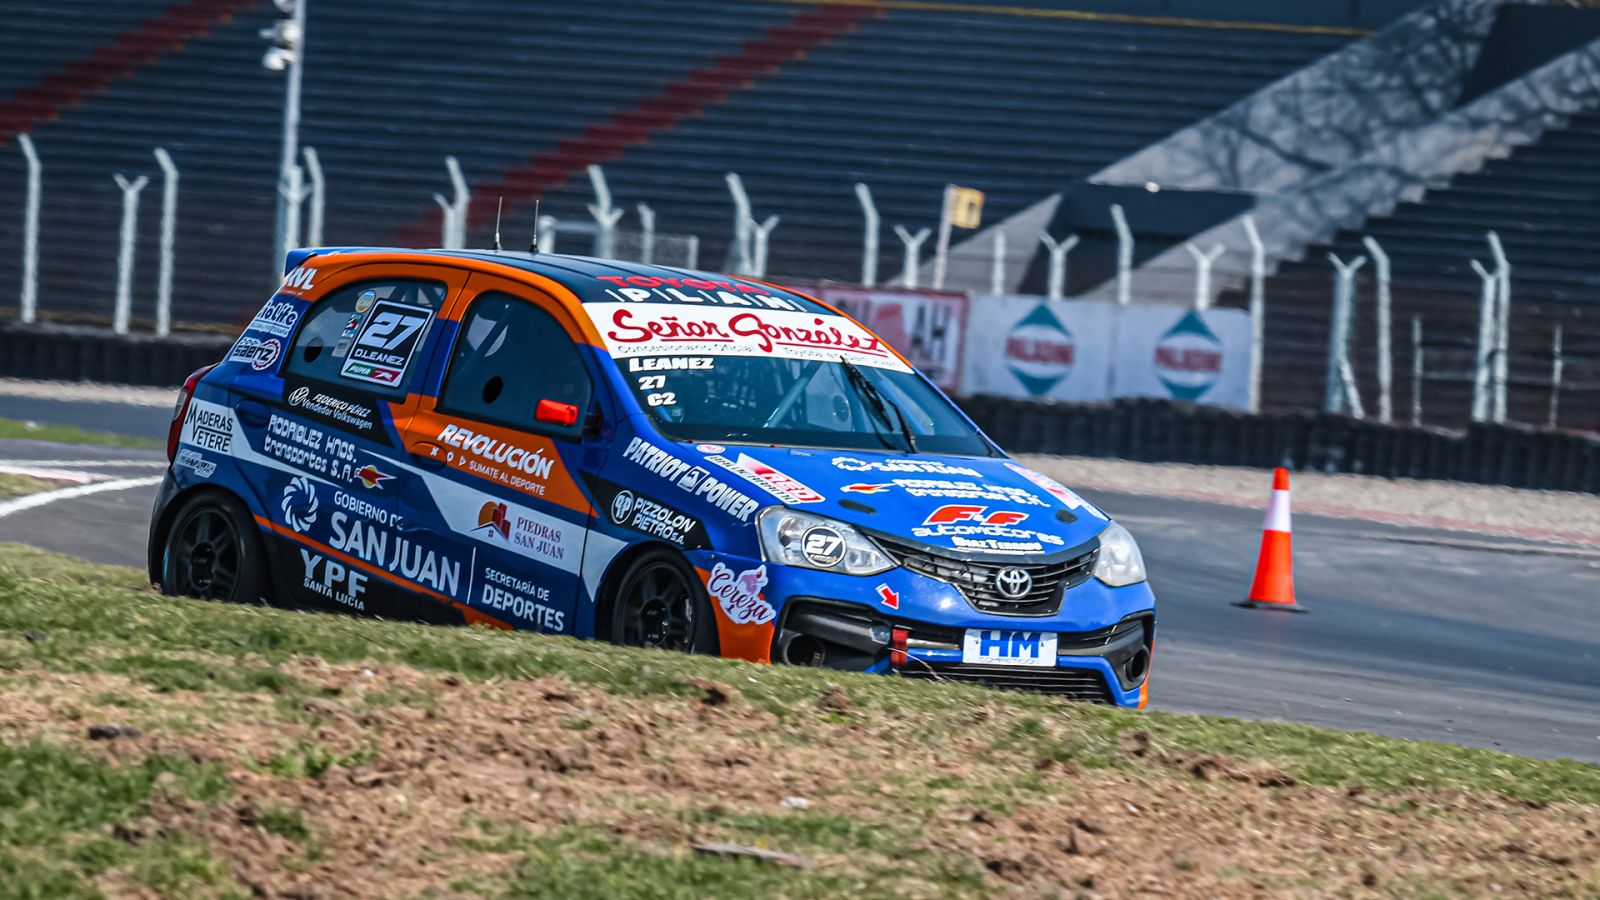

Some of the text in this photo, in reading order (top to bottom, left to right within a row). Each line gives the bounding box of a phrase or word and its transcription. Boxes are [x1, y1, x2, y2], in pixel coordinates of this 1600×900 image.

[597, 275, 770, 296] TOYOTA
[358, 311, 425, 351] 27
[608, 309, 883, 353] Señor González
[349, 365, 372, 375] PUMA
[629, 356, 714, 373] LEANEZ
[638, 375, 667, 391] 27
[646, 392, 677, 407] C2
[185, 402, 233, 432] MADERAS
[302, 398, 373, 430] Vendedor Volkswagen
[312, 393, 372, 418] FEDERICO PÉREZ
[268, 414, 323, 450] RODRIGUEZ
[263, 434, 328, 473] transportes
[437, 423, 555, 480] REVOLUCIÓN
[468, 460, 546, 496] SUMATE AL DEPORTE
[622, 436, 686, 482] PATRIOT
[694, 477, 760, 523] POWER
[333, 490, 388, 525] GOBIERNO
[633, 497, 697, 533] PIZZOLON
[514, 532, 565, 560] SAN JUAN
[515, 516, 562, 543] PIEDRAS
[804, 533, 843, 554] 27
[329, 511, 461, 598] SAN JUAN
[300, 549, 368, 598] YPF
[303, 577, 333, 599] SANTA
[484, 567, 550, 602] SECRETARÍA DE
[481, 584, 565, 633] DEPORTES
[708, 566, 775, 621] Cereza
[979, 630, 1041, 659] HM
